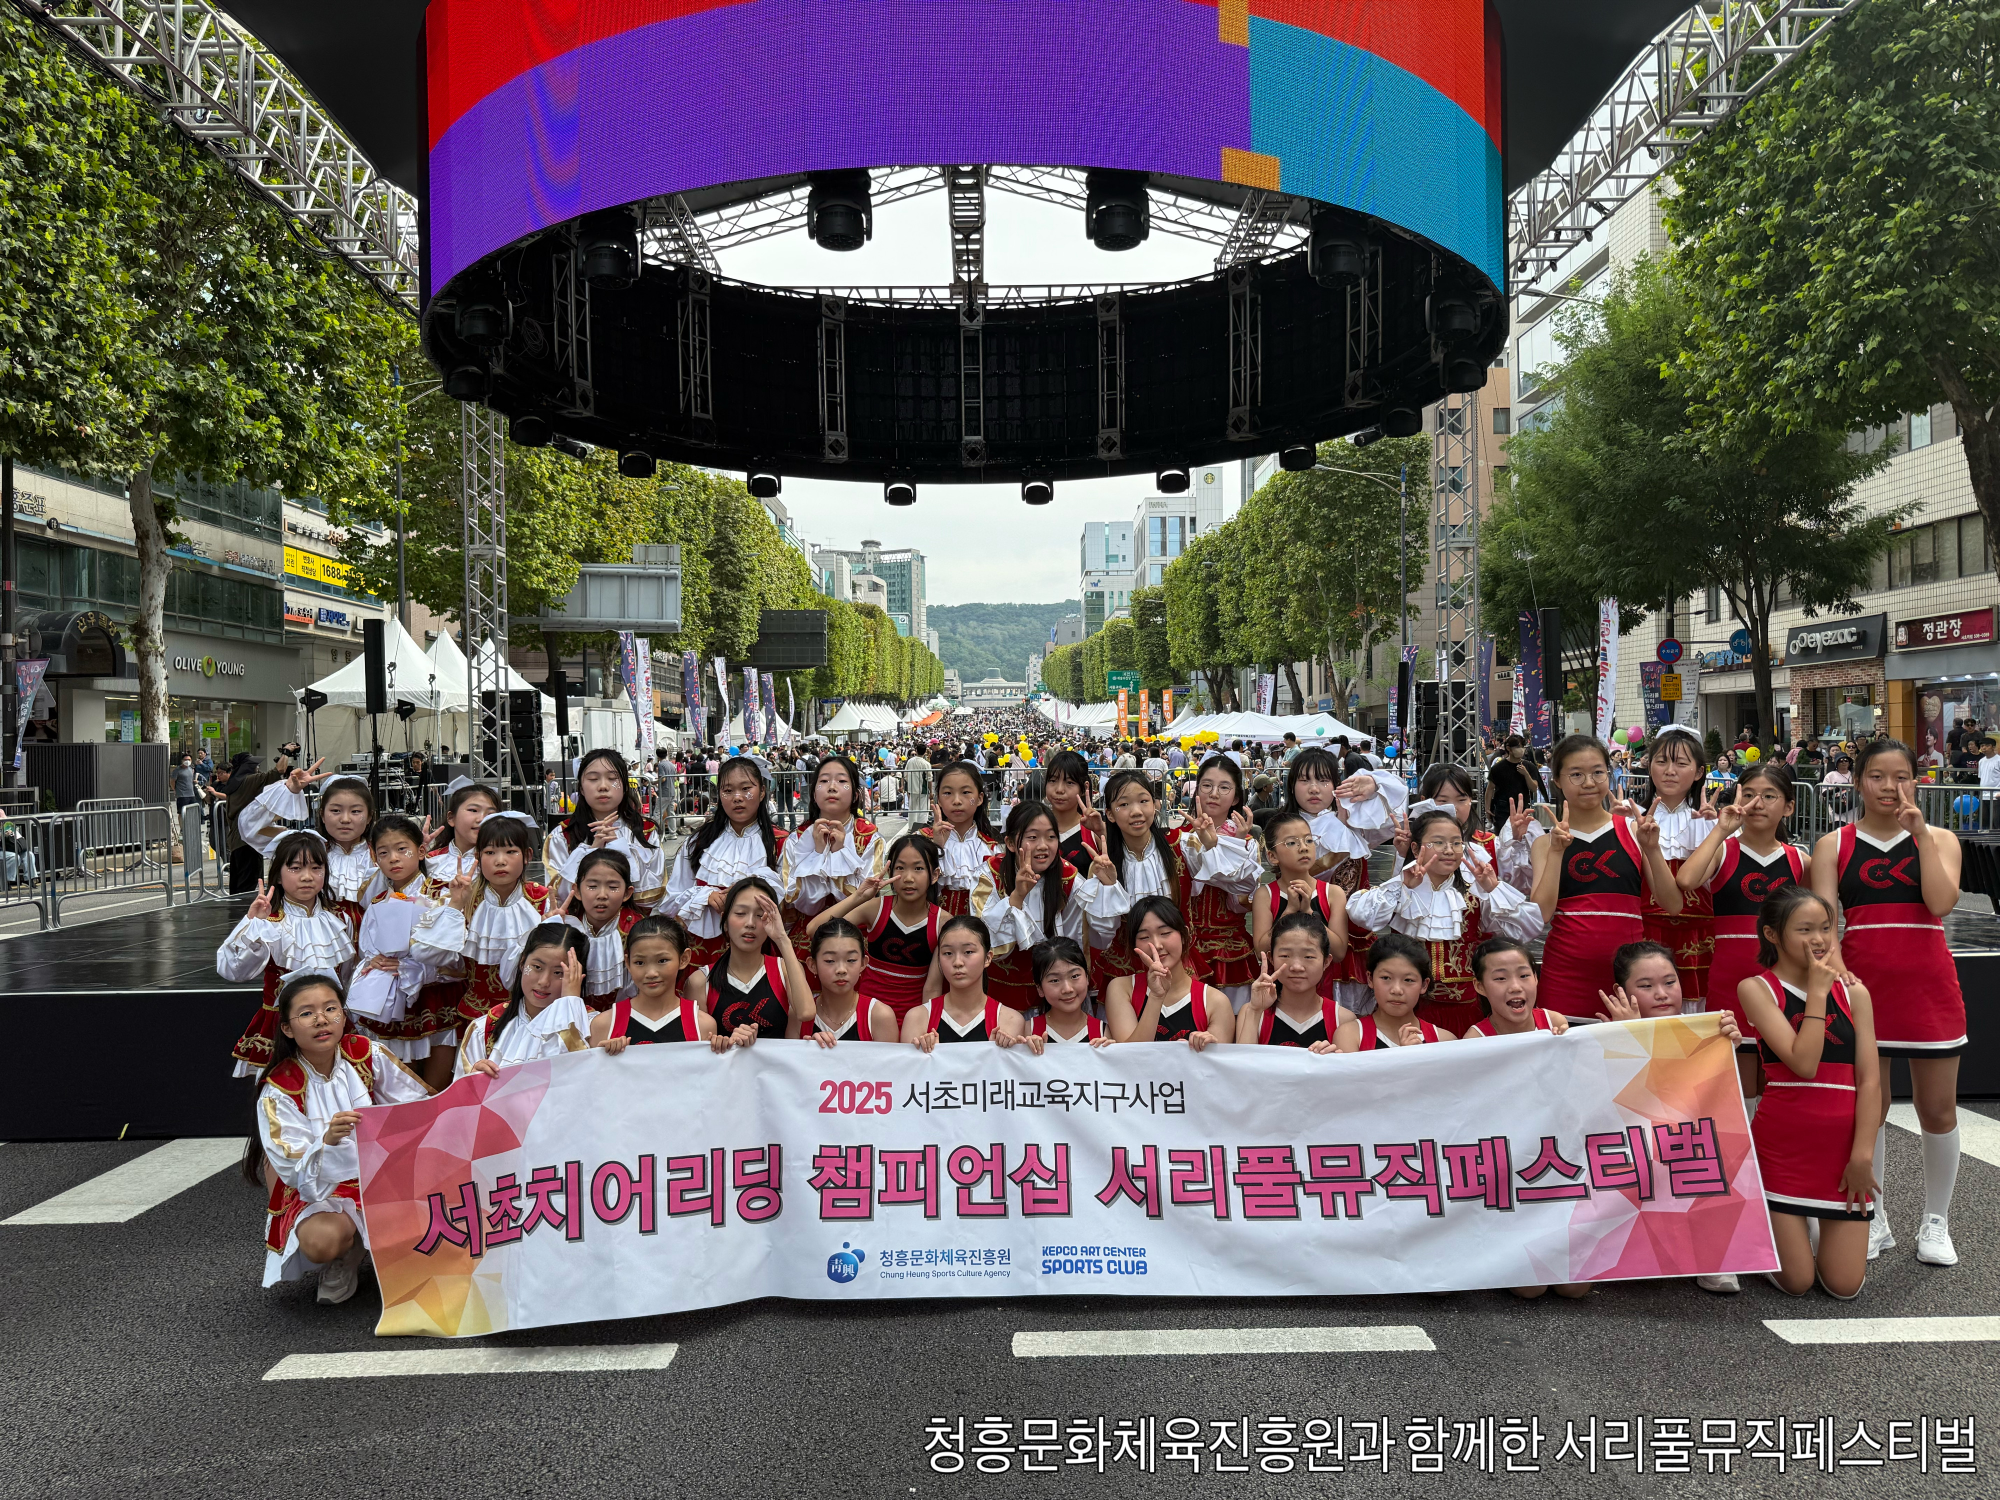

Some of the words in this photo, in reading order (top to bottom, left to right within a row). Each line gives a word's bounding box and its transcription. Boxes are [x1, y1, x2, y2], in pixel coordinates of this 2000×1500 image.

[1923, 618, 1963, 641] 정관장
[175, 656, 202, 672] OLIVE
[216, 661, 245, 676] YOUNG
[818, 1080, 893, 1115] 2025
[902, 1079, 1186, 1114] 서초미래교육지구사업
[413, 1143, 783, 1258] 서초치어리딩
[807, 1142, 1073, 1221] 챔피언십
[1095, 1117, 1729, 1220] 서리풀뮤직페스티벌
[879, 1248, 1011, 1268] 청흥문화체육진흥원
[1042, 1245, 1077, 1257] KEPCO
[1080, 1245, 1101, 1257] ART
[1103, 1246, 1147, 1258] CENTER
[879, 1270, 905, 1280] Chung
[906, 1270, 930, 1280] Heung
[931, 1269, 956, 1279] Sports
[957, 1269, 982, 1278] Culture
[983, 1269, 1011, 1279] Agency
[1041, 1259, 1103, 1275] SPORTS
[1106, 1259, 1148, 1275] CLUB
